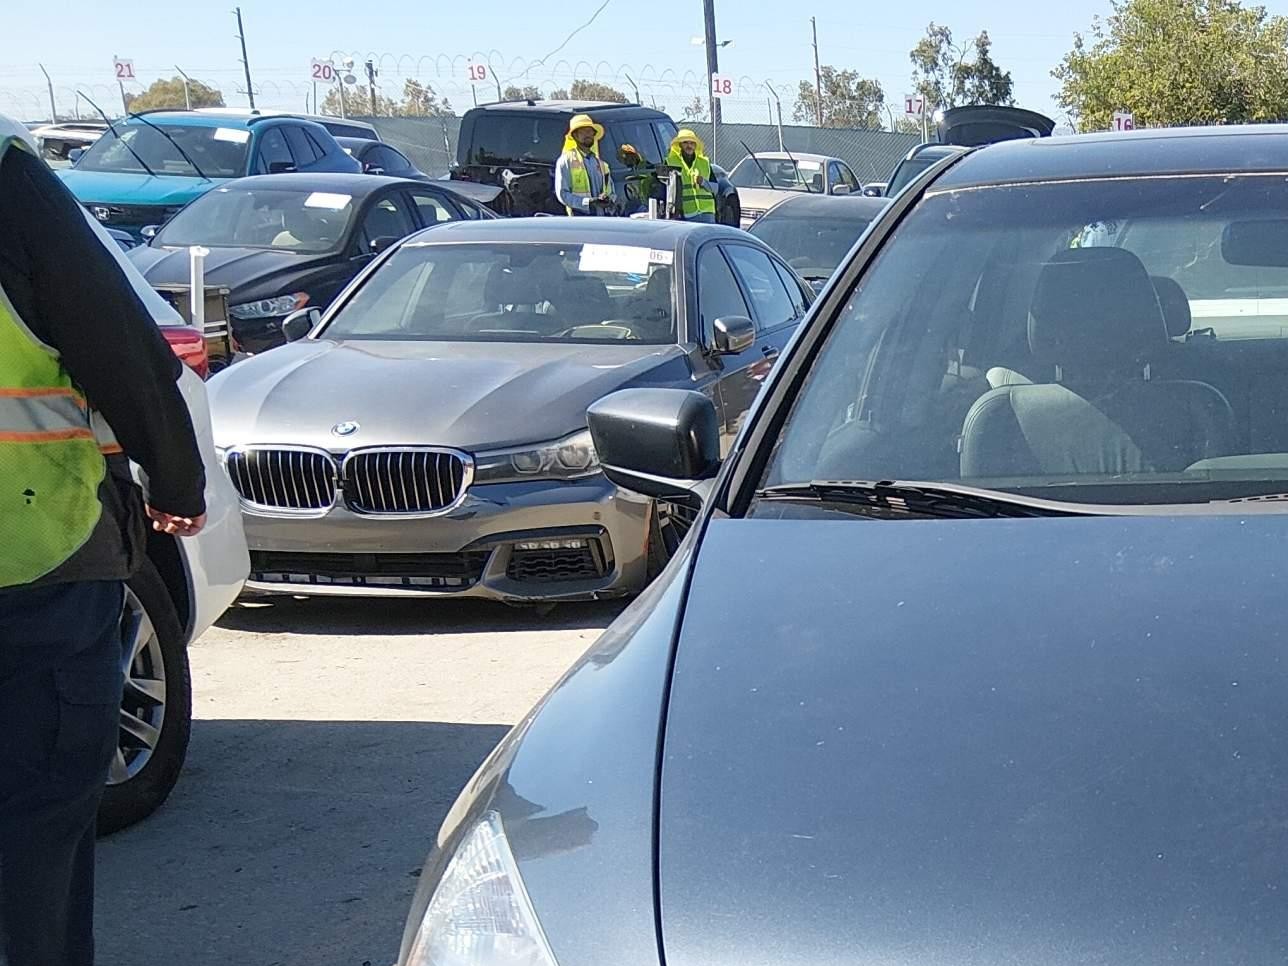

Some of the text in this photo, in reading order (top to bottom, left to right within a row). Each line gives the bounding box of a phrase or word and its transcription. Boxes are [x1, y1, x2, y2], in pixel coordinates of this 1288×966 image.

[115, 63, 135, 78] 21
[312, 63, 332, 80] 20
[468, 65, 486, 81] 19
[713, 79, 732, 94] 18
[905, 99, 923, 114] 17
[1115, 117, 1134, 131] 16
